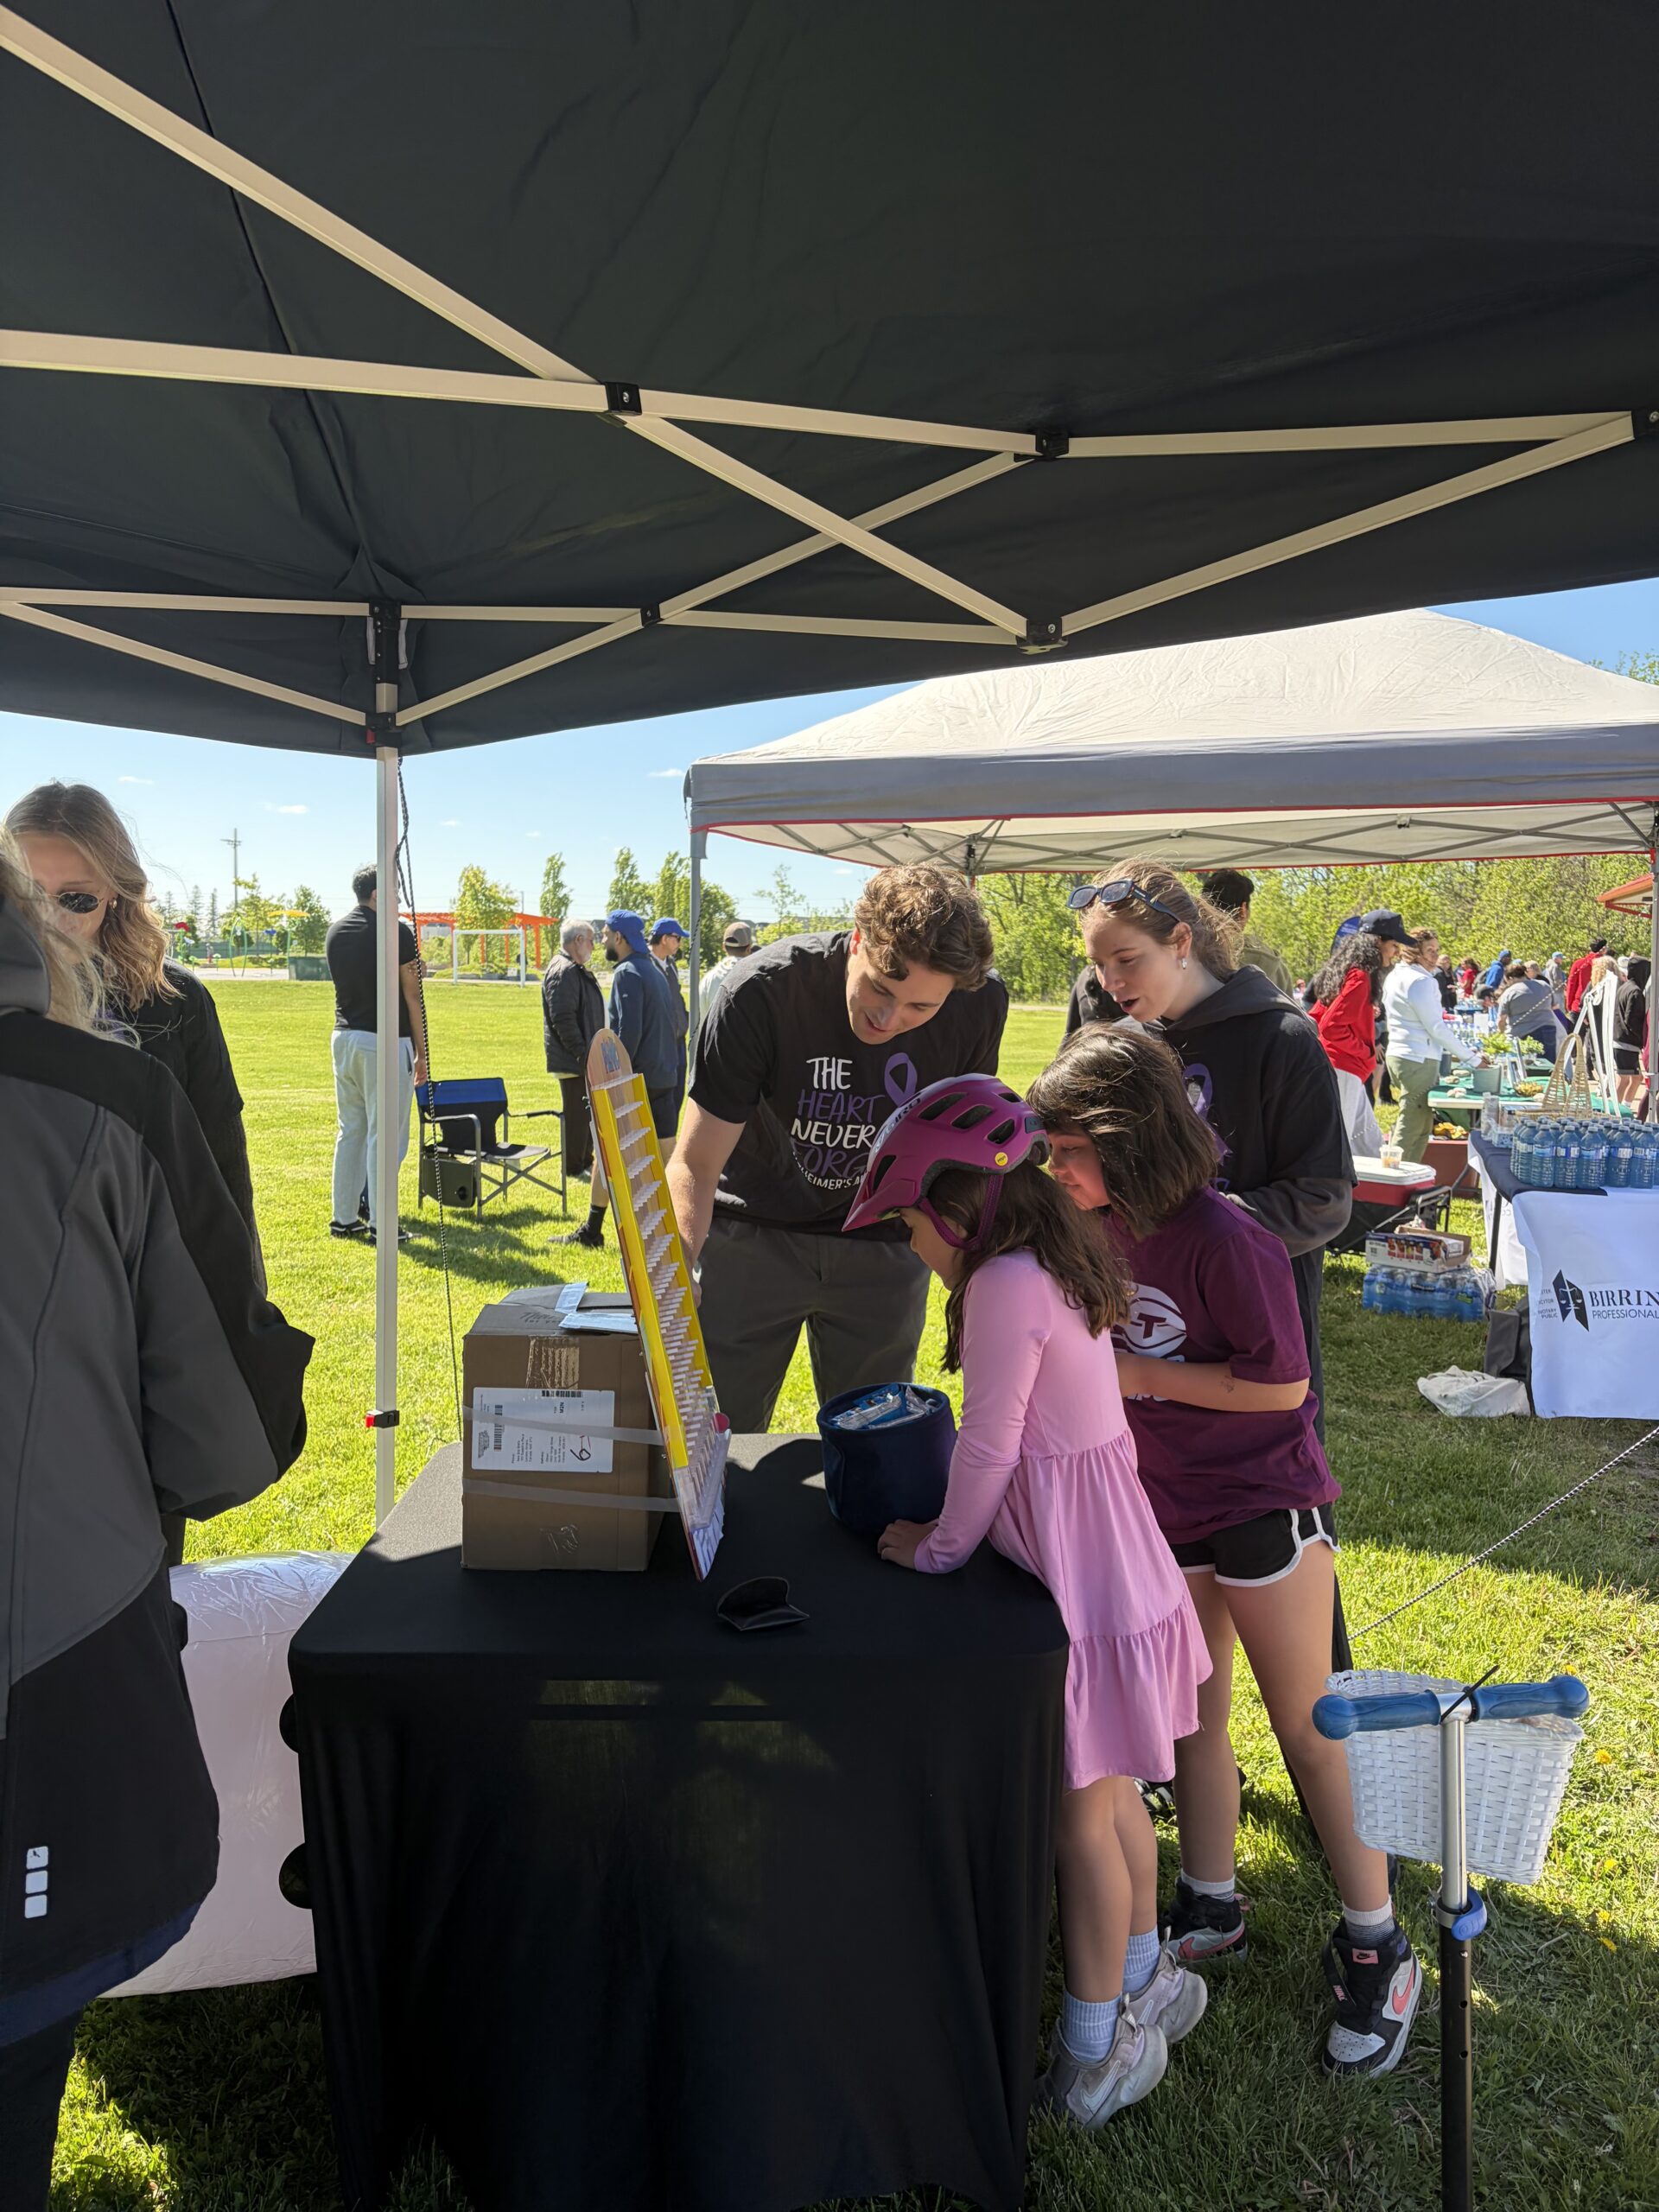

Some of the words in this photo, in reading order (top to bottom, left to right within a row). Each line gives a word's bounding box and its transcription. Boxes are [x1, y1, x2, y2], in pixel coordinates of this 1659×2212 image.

[806, 1057, 854, 1090] THE
[798, 1090, 885, 1122] HEART
[791, 1118, 875, 1149] NEVER
[1137, 1313, 1166, 1339] T
[1592, 1309, 1659, 1319] PROFESSIONAL
